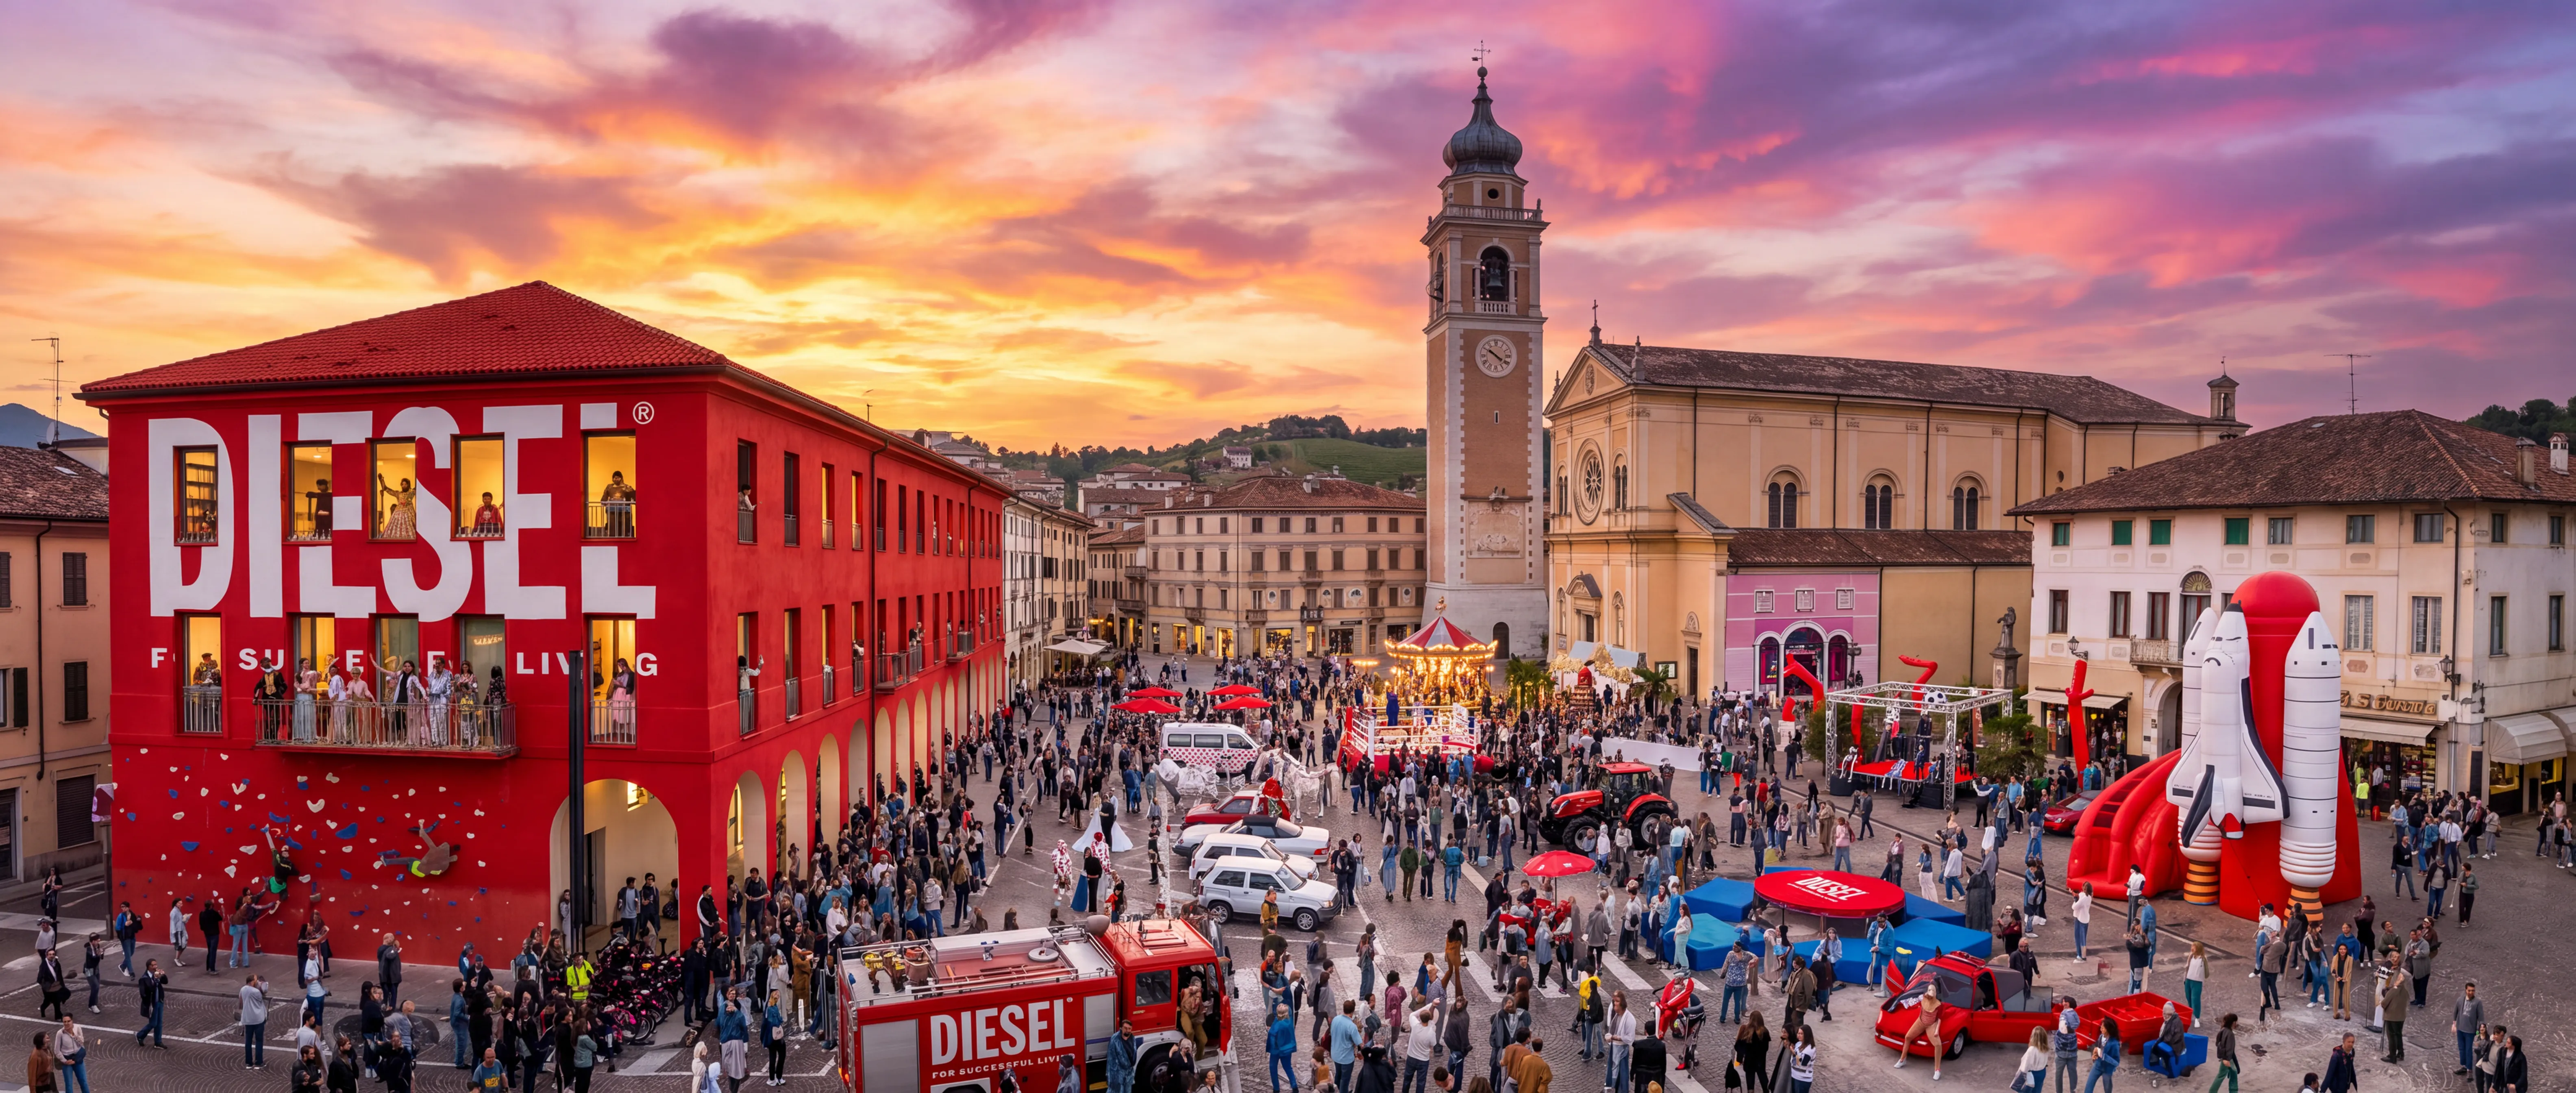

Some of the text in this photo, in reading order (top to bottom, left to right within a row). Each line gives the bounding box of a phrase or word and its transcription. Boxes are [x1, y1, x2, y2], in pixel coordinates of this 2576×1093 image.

[149, 402, 656, 622] DIESEL
[930, 999, 1075, 1065] DIESEL
[932, 1053, 1075, 1079] FOR SUCCESSFUL LIVI
